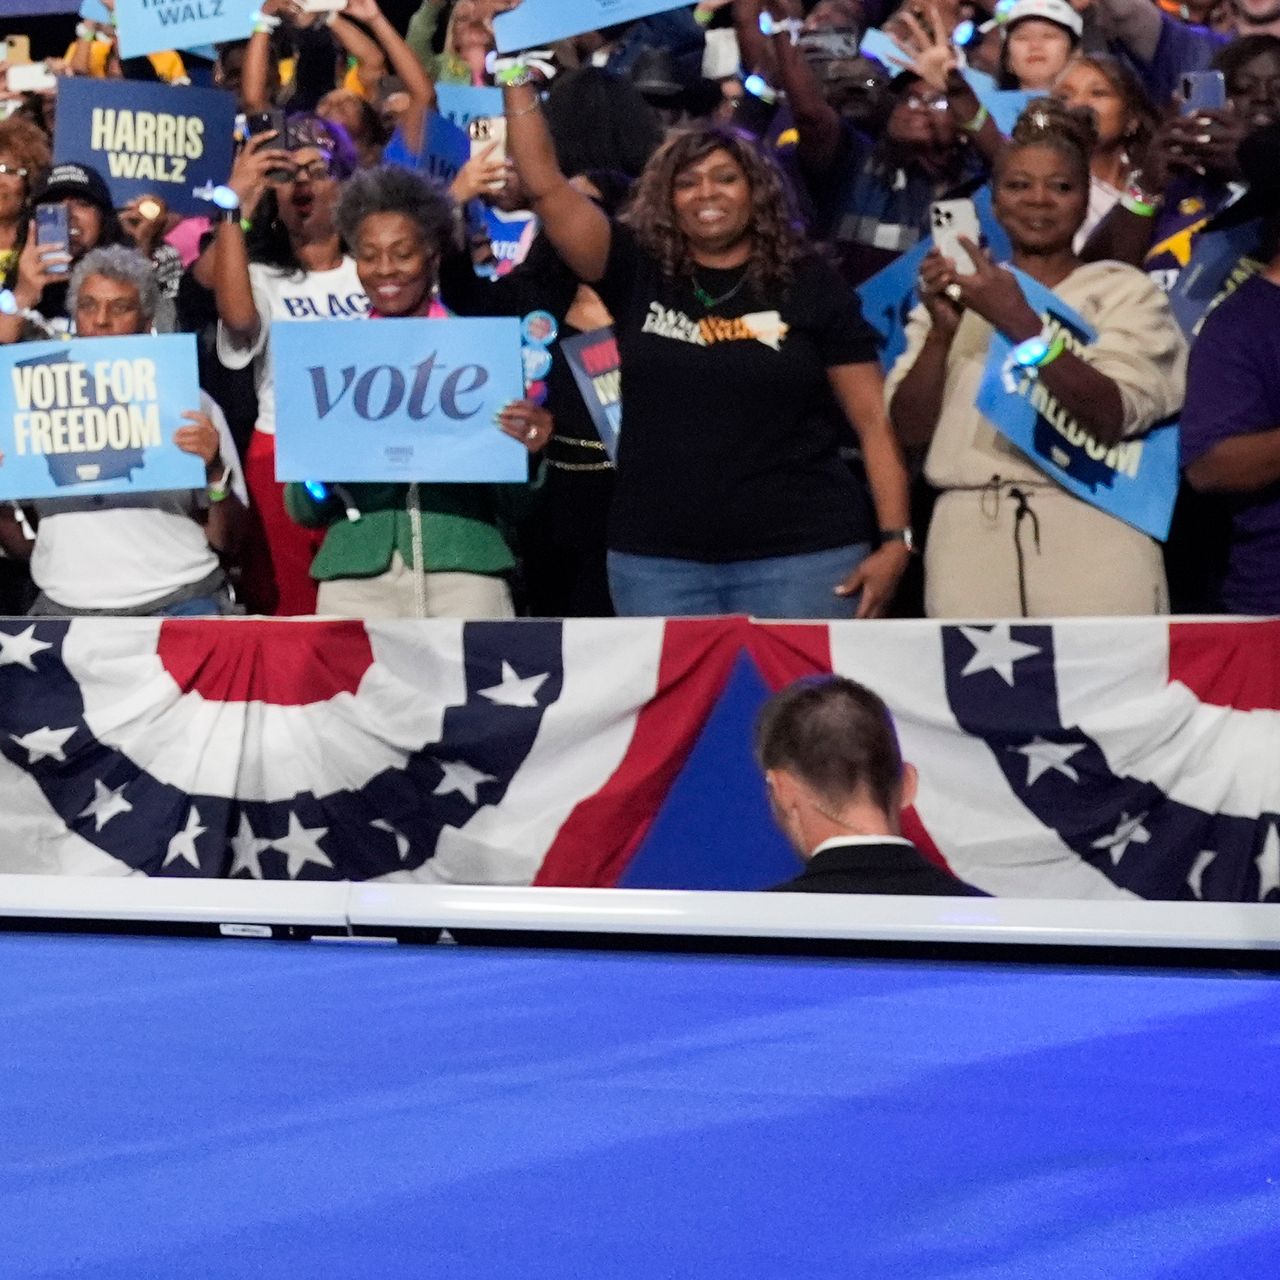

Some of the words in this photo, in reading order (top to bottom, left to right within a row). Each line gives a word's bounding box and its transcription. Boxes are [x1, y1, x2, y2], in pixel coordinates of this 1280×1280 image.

[158, 0, 224, 26] WALZ
[91, 107, 204, 159] HARRIS
[107, 150, 188, 183] WALZ
[283, 293, 371, 317] BLAC
[11, 361, 89, 410] VOTE
[94, 357, 157, 405] FOR
[307, 348, 489, 420] vote
[14, 402, 161, 456] FREEDOM
